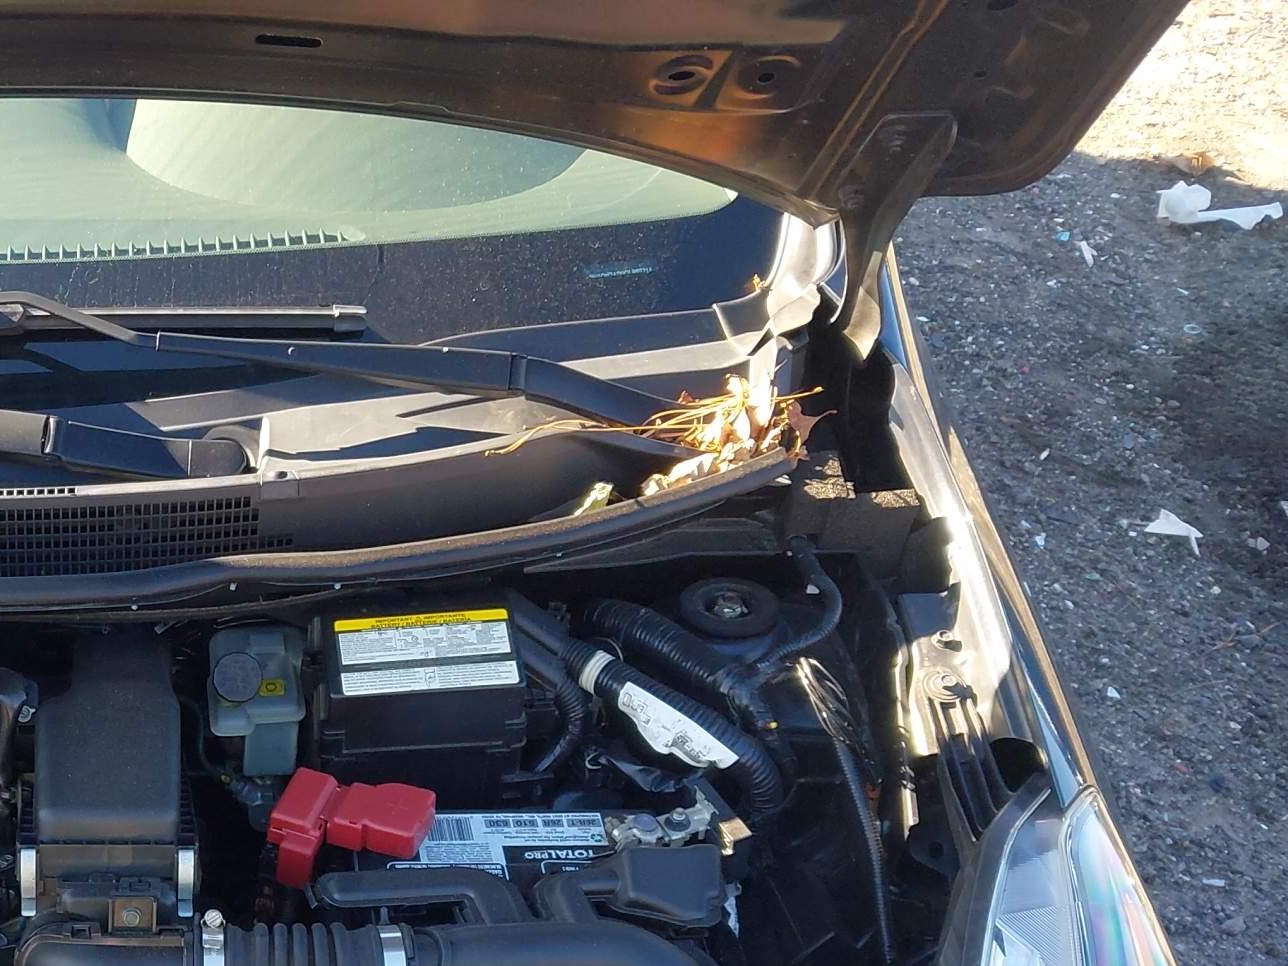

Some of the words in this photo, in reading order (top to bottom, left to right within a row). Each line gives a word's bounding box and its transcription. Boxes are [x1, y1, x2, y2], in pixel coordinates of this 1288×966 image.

[371, 621, 402, 629] BATTERY
[406, 618, 440, 627] BATTERIE
[375, 616, 413, 624] IMPORTANT
[423, 613, 466, 621] IMPORTANTE
